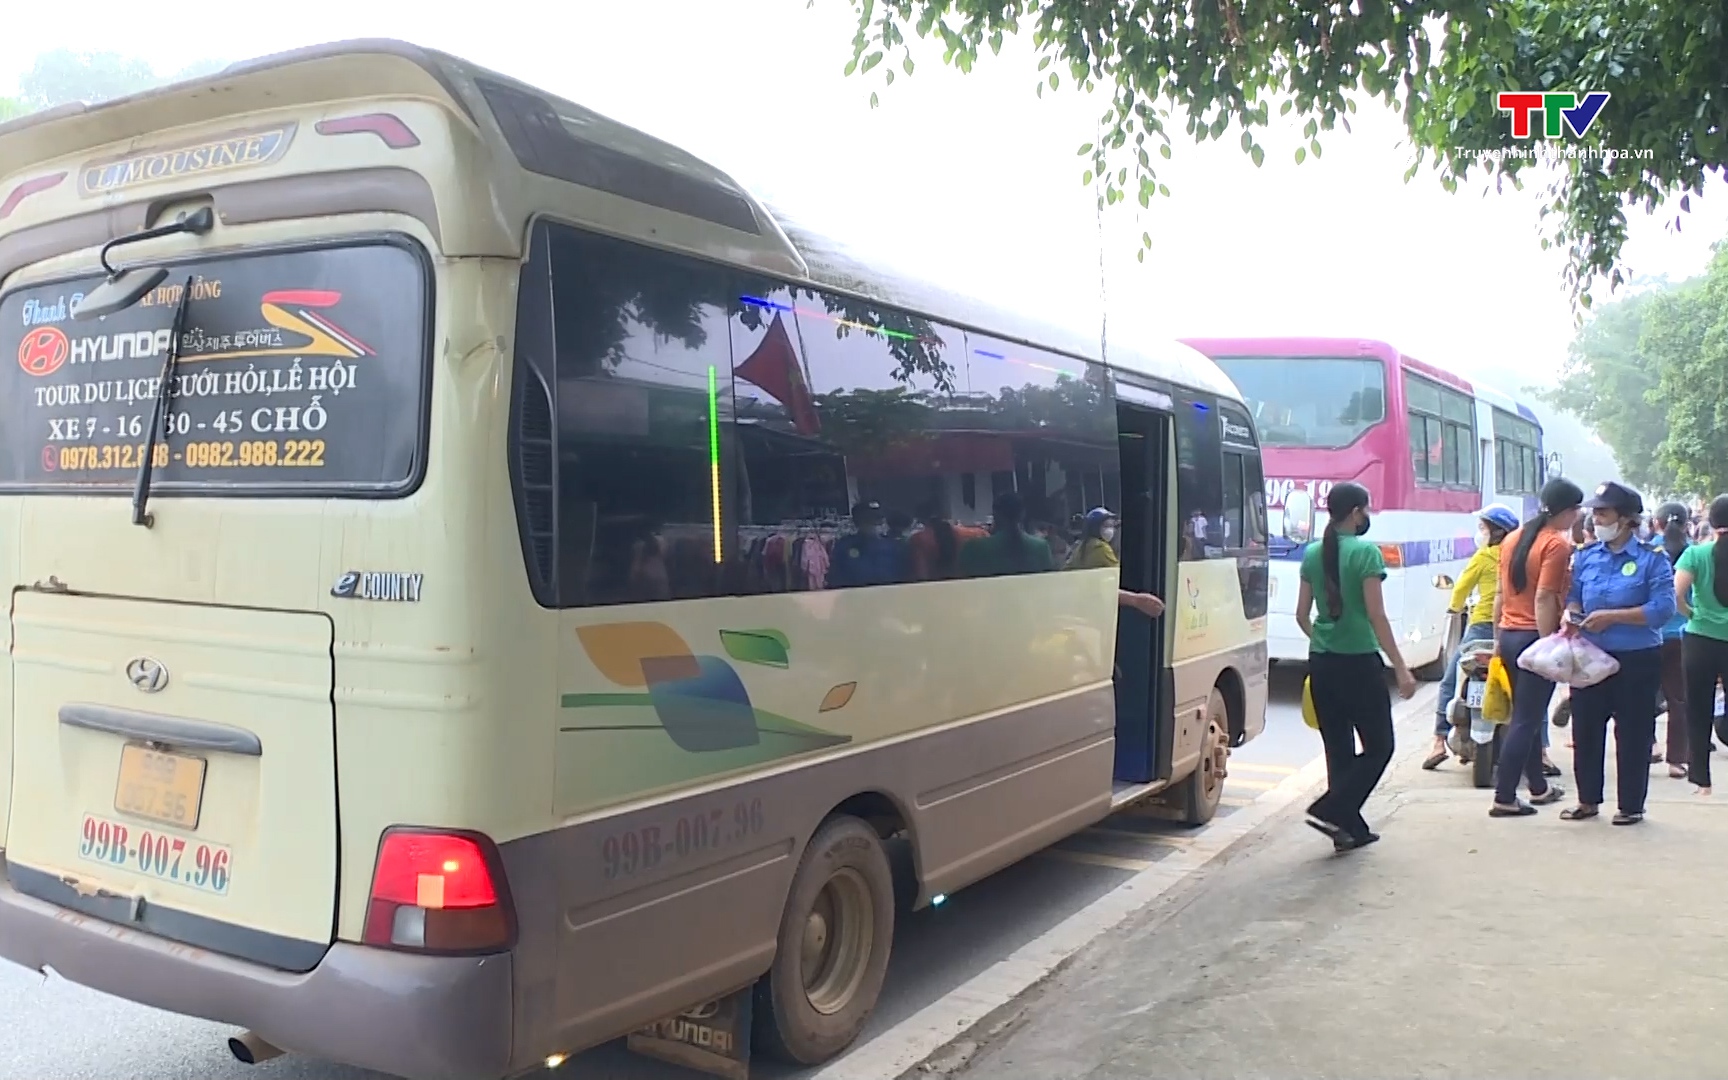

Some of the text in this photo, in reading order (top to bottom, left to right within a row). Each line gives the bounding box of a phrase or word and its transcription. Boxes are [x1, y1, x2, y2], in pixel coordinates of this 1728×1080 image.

[95, 137, 265, 190] LIMOUSINE
[34, 383, 80, 407] TOUR
[84, 381, 112, 403] DU
[115, 376, 163, 406] LỊCH
[308, 359, 358, 396] HỘI
[47, 418, 80, 440] XE
[85, 417, 97, 439] 7
[116, 415, 142, 437] 16
[166, 411, 191, 434] 30
[212, 409, 243, 434] 45
[250, 394, 328, 433] CHỖ
[186, 439, 326, 468] 0982.988.222
[362, 573, 422, 601] COUNTY
[81, 816, 229, 891] 99B-007.96
[603, 799, 764, 879] 99B-007.96
